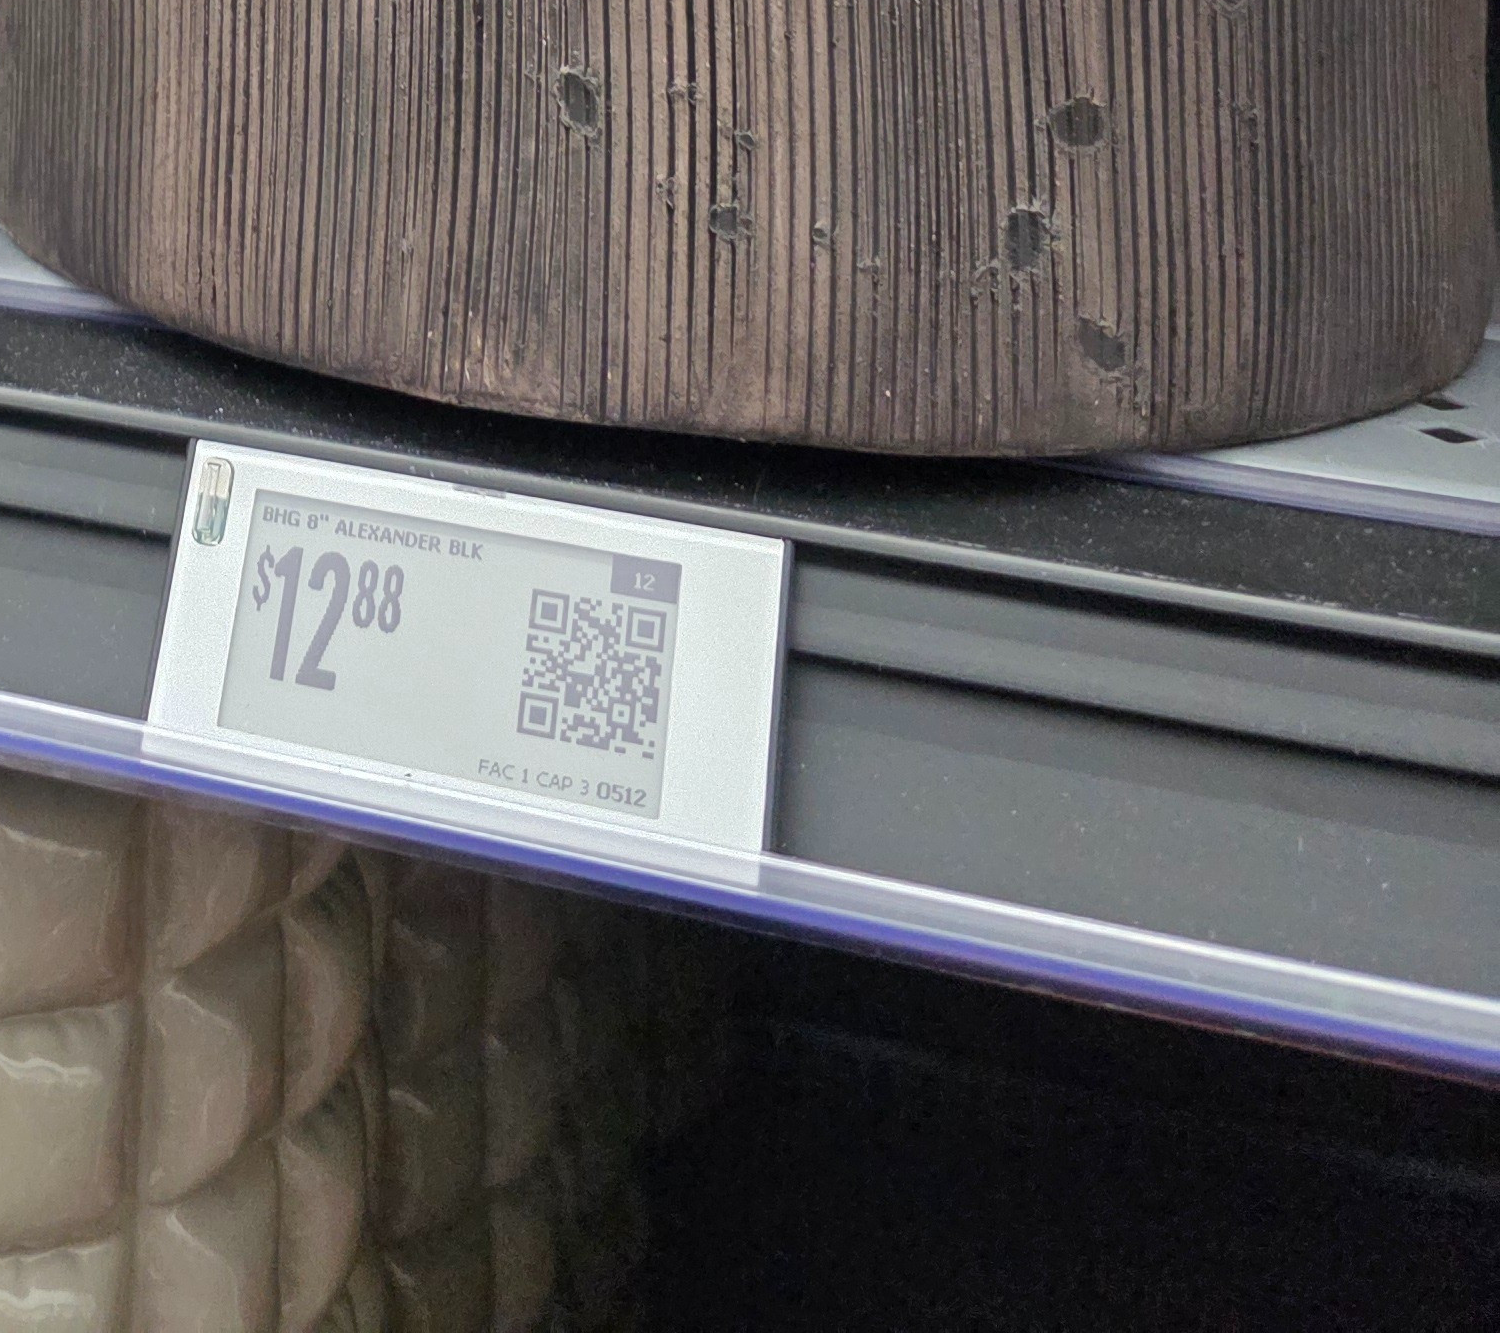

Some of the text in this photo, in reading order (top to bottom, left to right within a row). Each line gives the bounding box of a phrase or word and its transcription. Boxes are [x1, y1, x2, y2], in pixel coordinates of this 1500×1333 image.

[262, 505, 485, 561] BHG 8" ALEXANDER BLK
[633, 571, 656, 592] 12
[478, 758, 648, 808] FAC 1 CAP 3 0512
